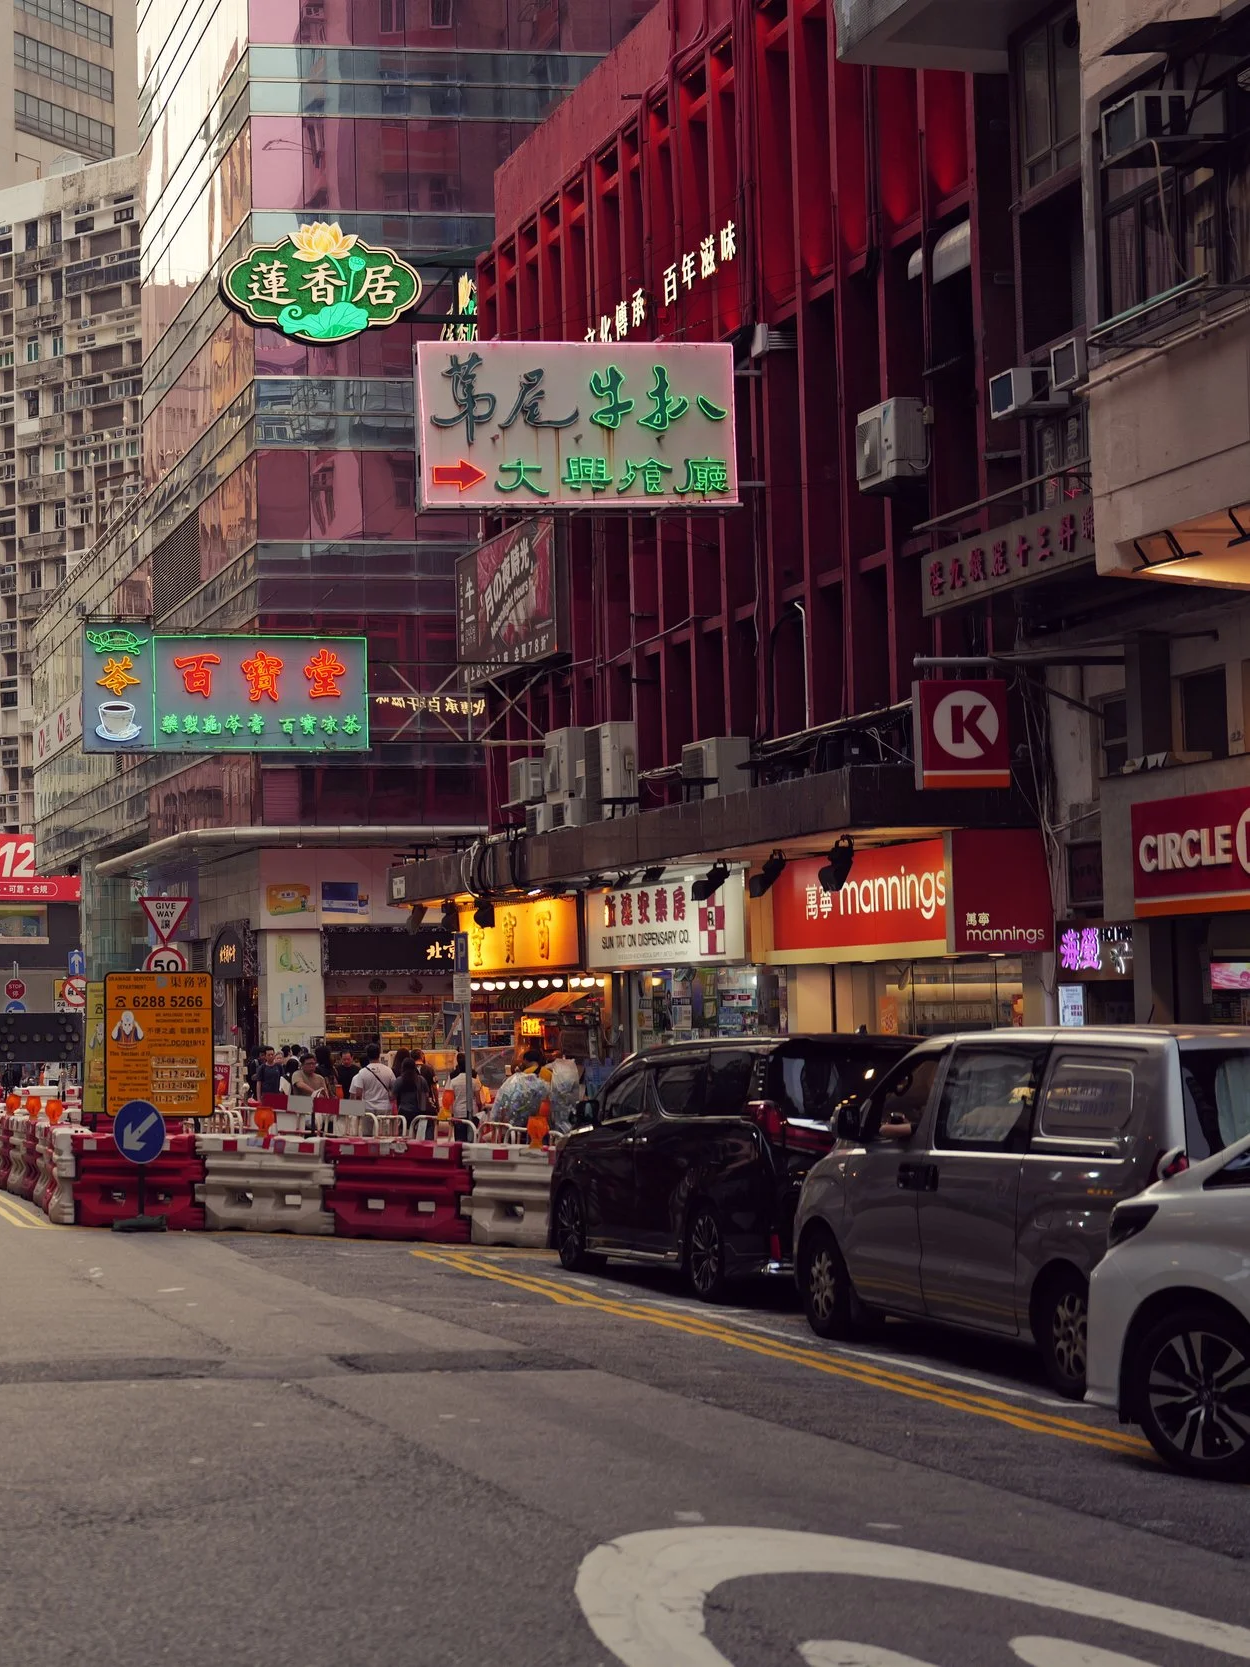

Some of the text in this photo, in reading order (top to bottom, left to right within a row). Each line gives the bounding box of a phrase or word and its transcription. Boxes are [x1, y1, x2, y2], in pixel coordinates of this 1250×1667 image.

[663, 220, 737, 307] 百年滋味
[247, 260, 400, 306] 蓮香居
[174, 648, 347, 702] 百寶堂
[951, 705, 995, 757] K
[1139, 825, 1233, 873] CIRCLE
[155, 902, 176, 910] GIVE
[839, 865, 946, 920] mannings
[965, 912, 990, 926] 萬寧
[966, 925, 1045, 944] mannings
[602, 936, 614, 949] SUN
[627, 933, 636, 946] ON
[638, 930, 677, 947] DISPENSARY
[154, 960, 179, 971] 50
[132, 996, 203, 1008] 6288 5266
